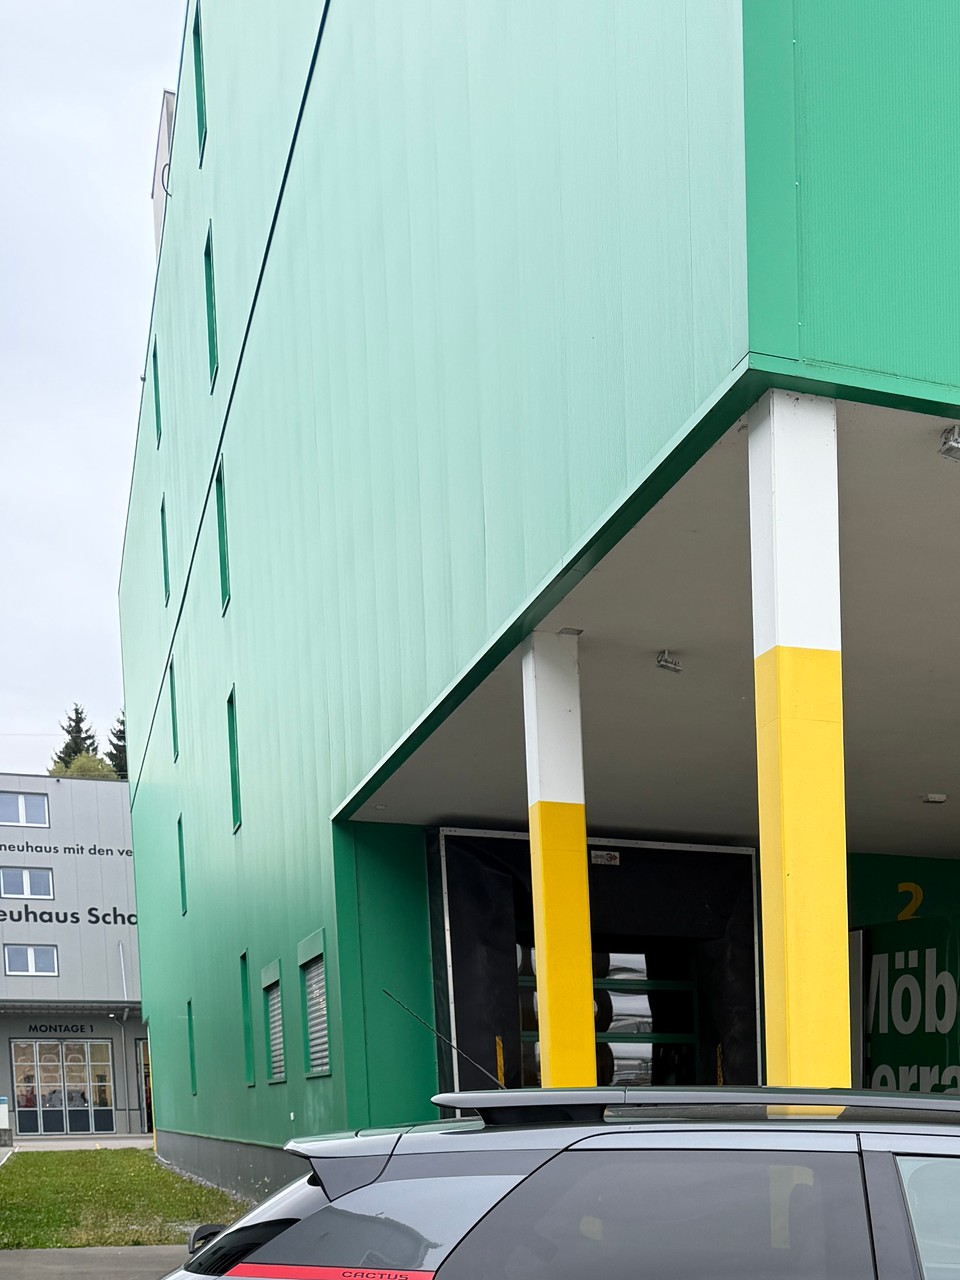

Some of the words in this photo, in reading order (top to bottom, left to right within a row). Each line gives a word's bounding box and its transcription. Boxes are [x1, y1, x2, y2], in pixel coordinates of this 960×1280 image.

[0, 841, 59, 854] neuhaus
[63, 844, 84, 855] mit
[88, 844, 114, 856] den
[28, 1024, 86, 1033] MONTAGE
[90, 1024, 94, 1033] 1
[342, 1271, 409, 1280] CACTUS
